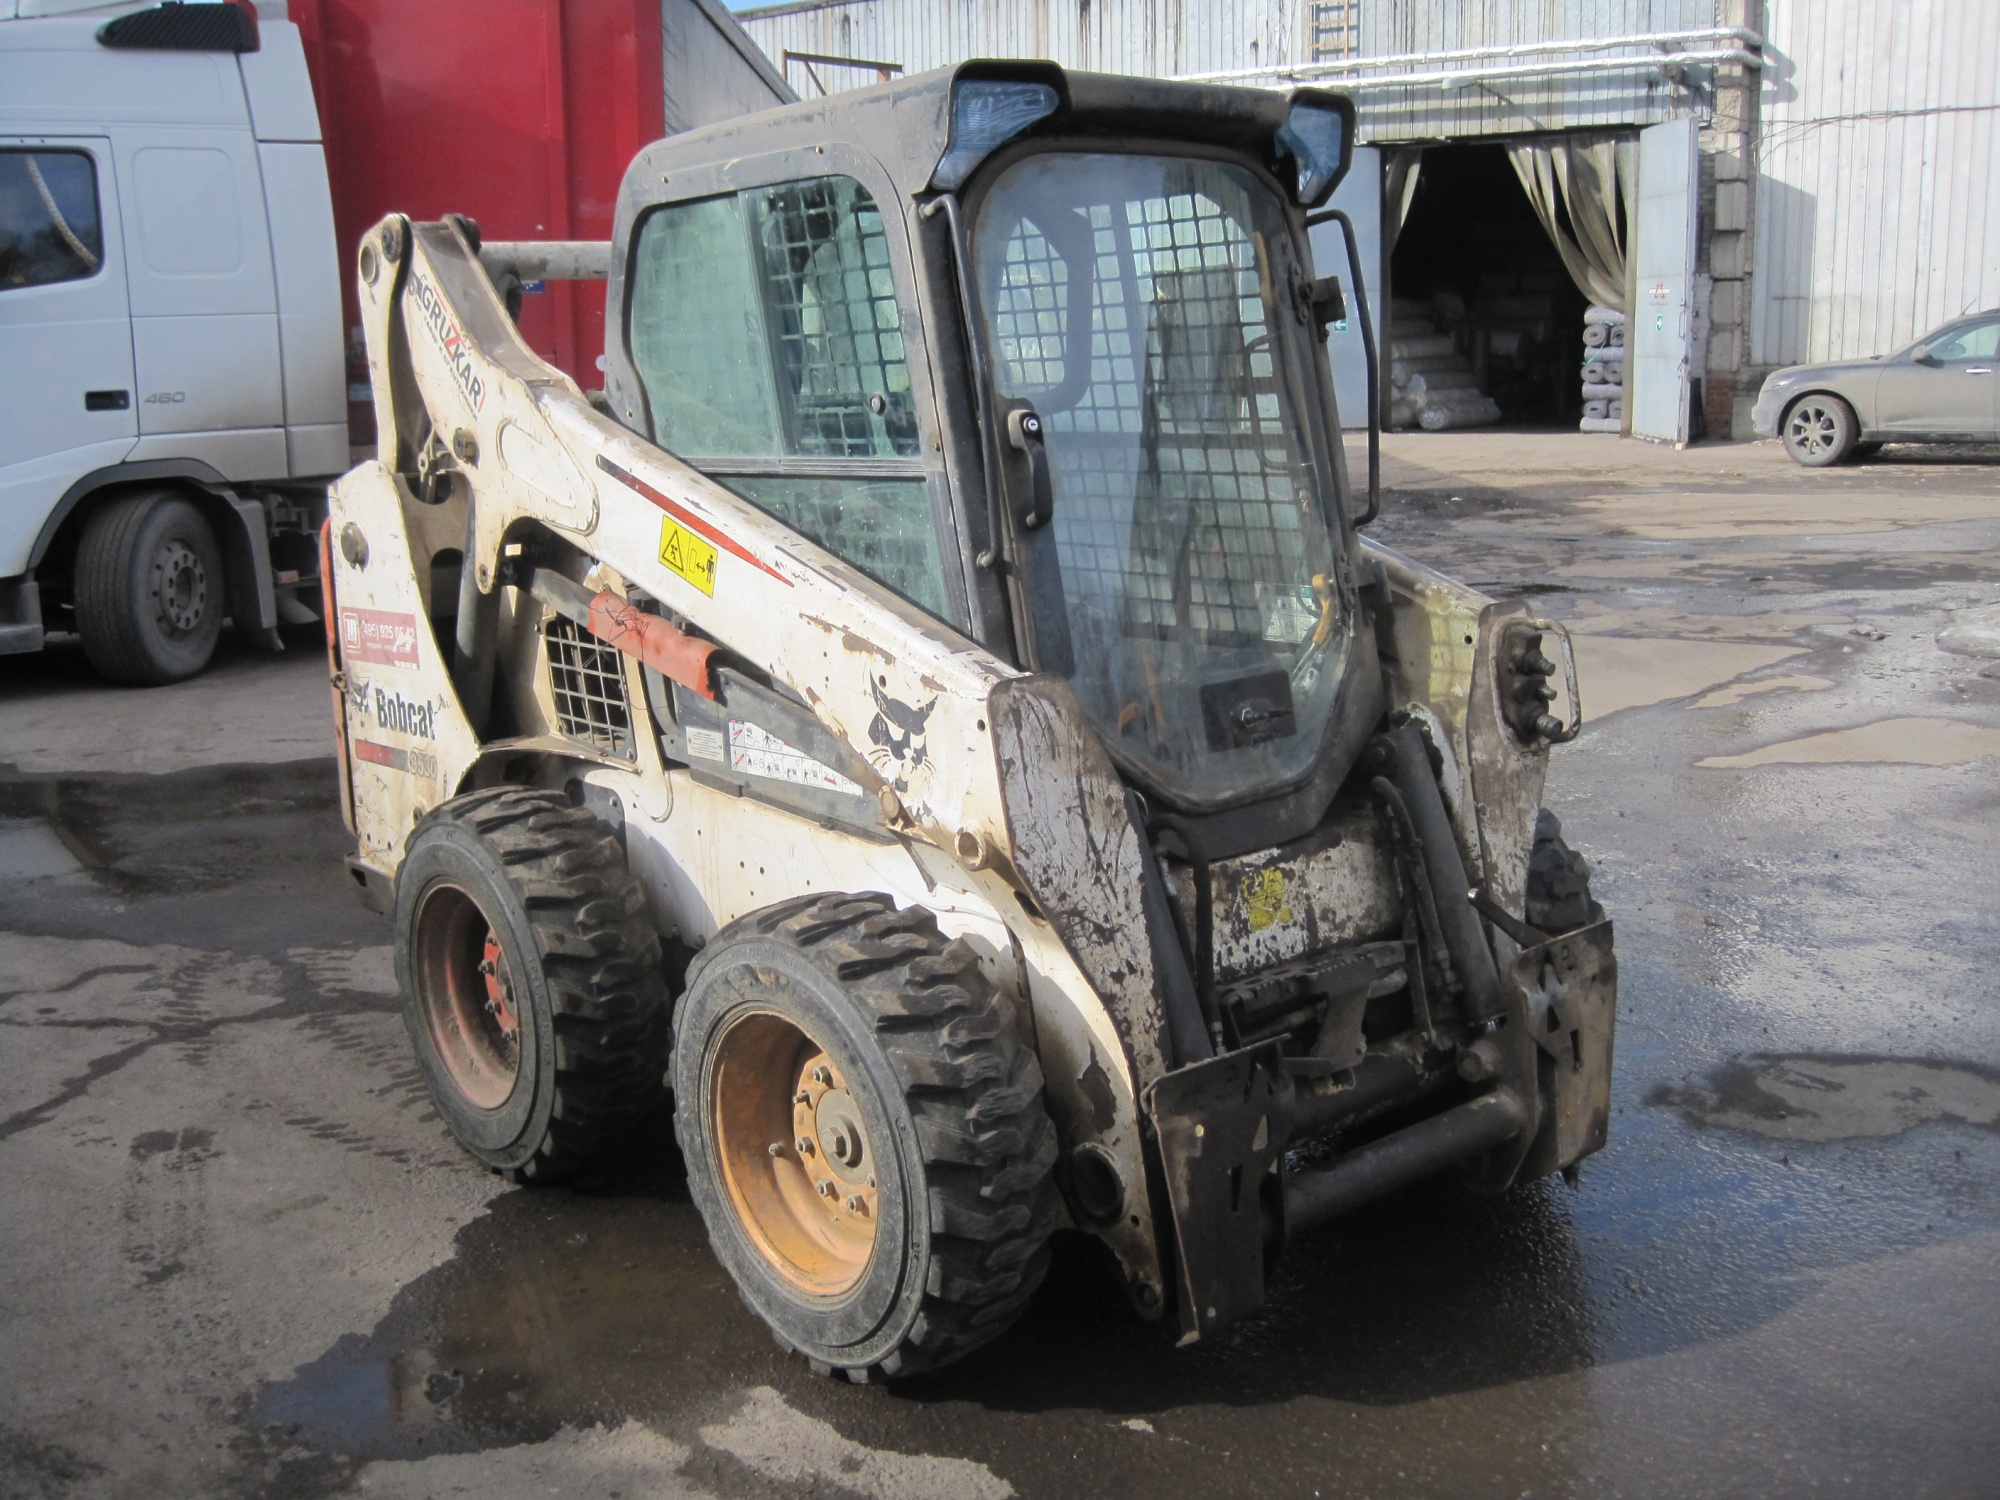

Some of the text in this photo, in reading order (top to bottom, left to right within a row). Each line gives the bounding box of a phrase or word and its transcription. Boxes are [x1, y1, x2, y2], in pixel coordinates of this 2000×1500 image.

[144, 391, 186, 405] 460
[380, 624, 394, 640] 925
[375, 688, 436, 740] Bobcat
